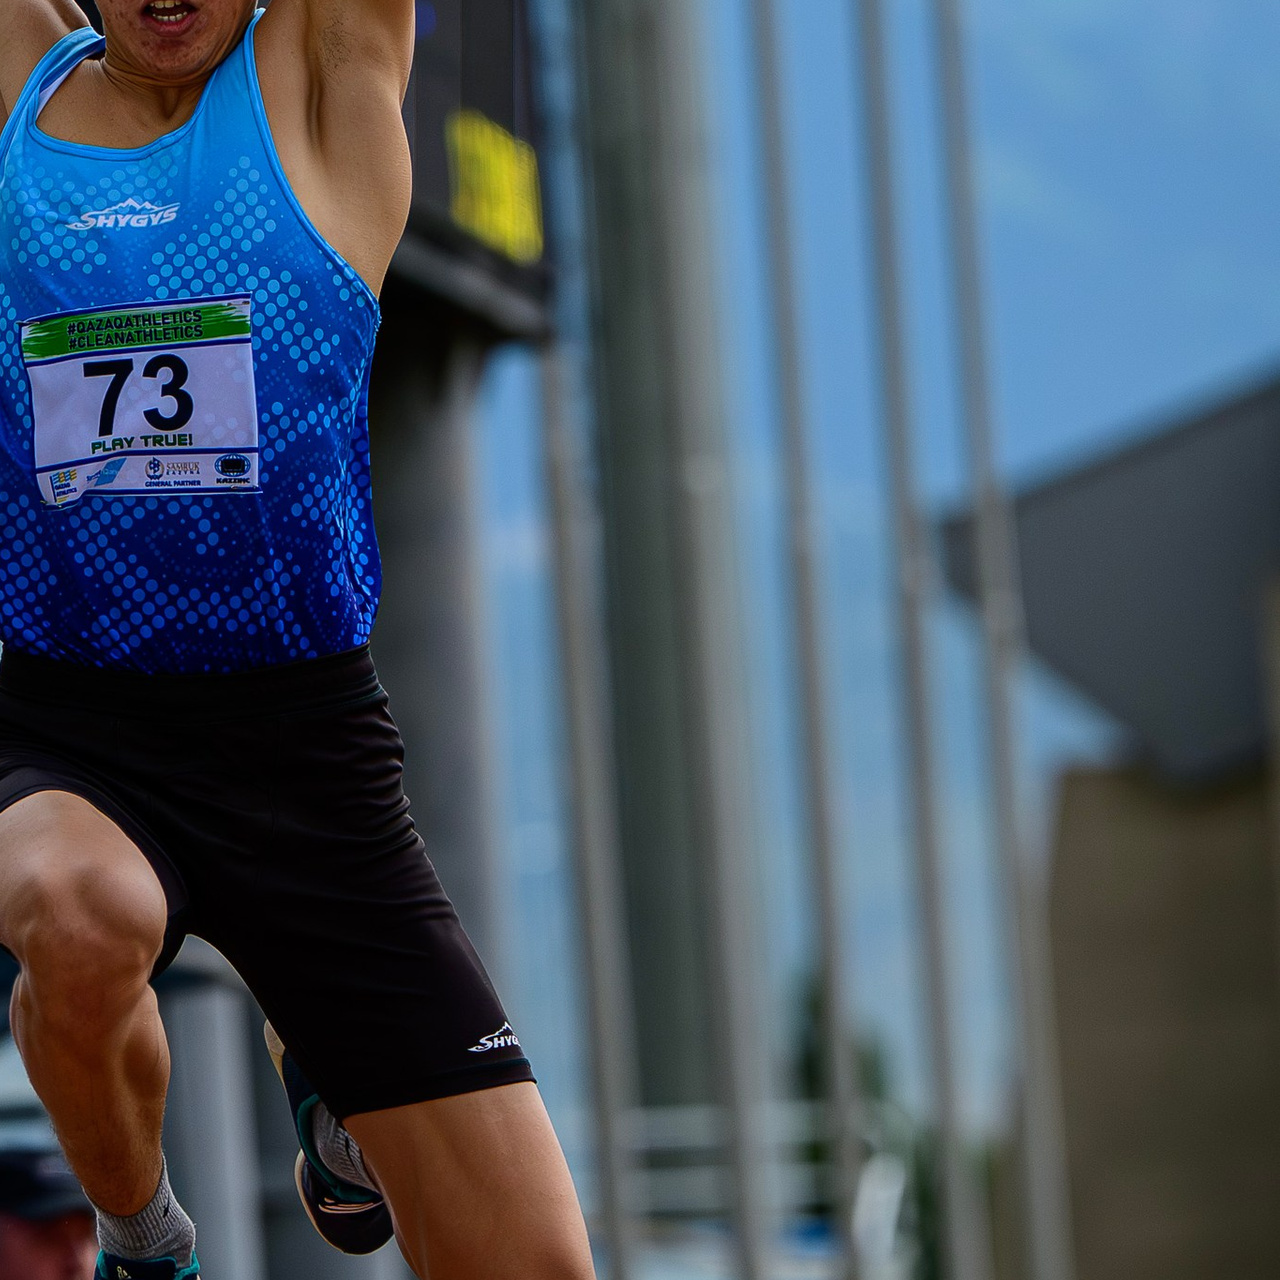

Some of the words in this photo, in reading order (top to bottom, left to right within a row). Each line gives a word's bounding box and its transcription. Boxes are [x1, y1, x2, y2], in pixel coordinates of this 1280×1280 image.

[65, 204, 181, 231] SHYGYS
[67, 310, 202, 335] #QAZAQATHLETICS
[68, 325, 203, 350] #CLEANATHLETICS
[83, 353, 194, 437] 73
[91, 436, 135, 455] PLAY
[140, 433, 193, 447] TRUE!
[173, 479, 201, 487] PARTNER
